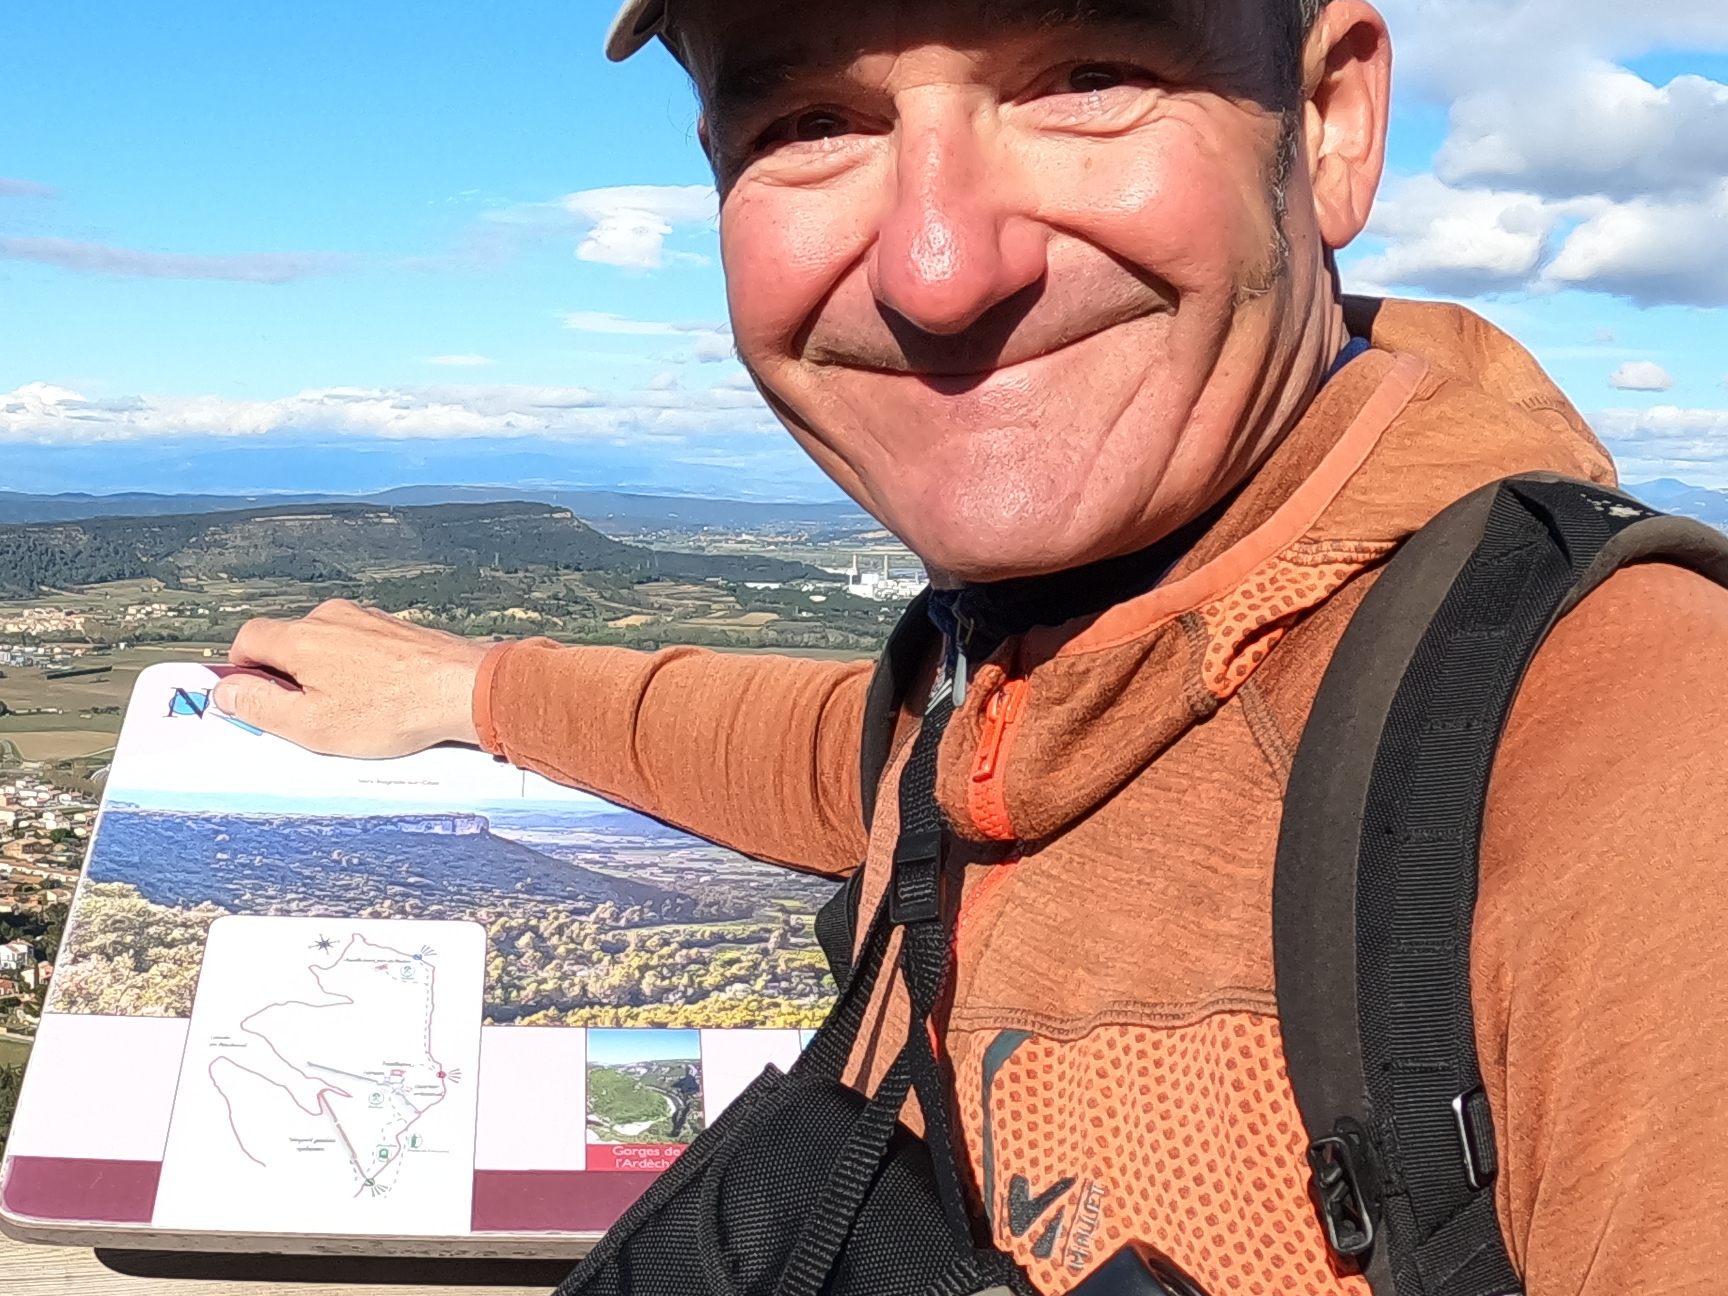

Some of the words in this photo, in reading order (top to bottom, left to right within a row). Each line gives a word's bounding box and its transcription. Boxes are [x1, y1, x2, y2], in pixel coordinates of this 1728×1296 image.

[162, 687, 214, 720] N
[612, 1146, 660, 1158] Gorges
[664, 1147, 681, 1156] de
[615, 1158, 671, 1169] l'Ardèch
